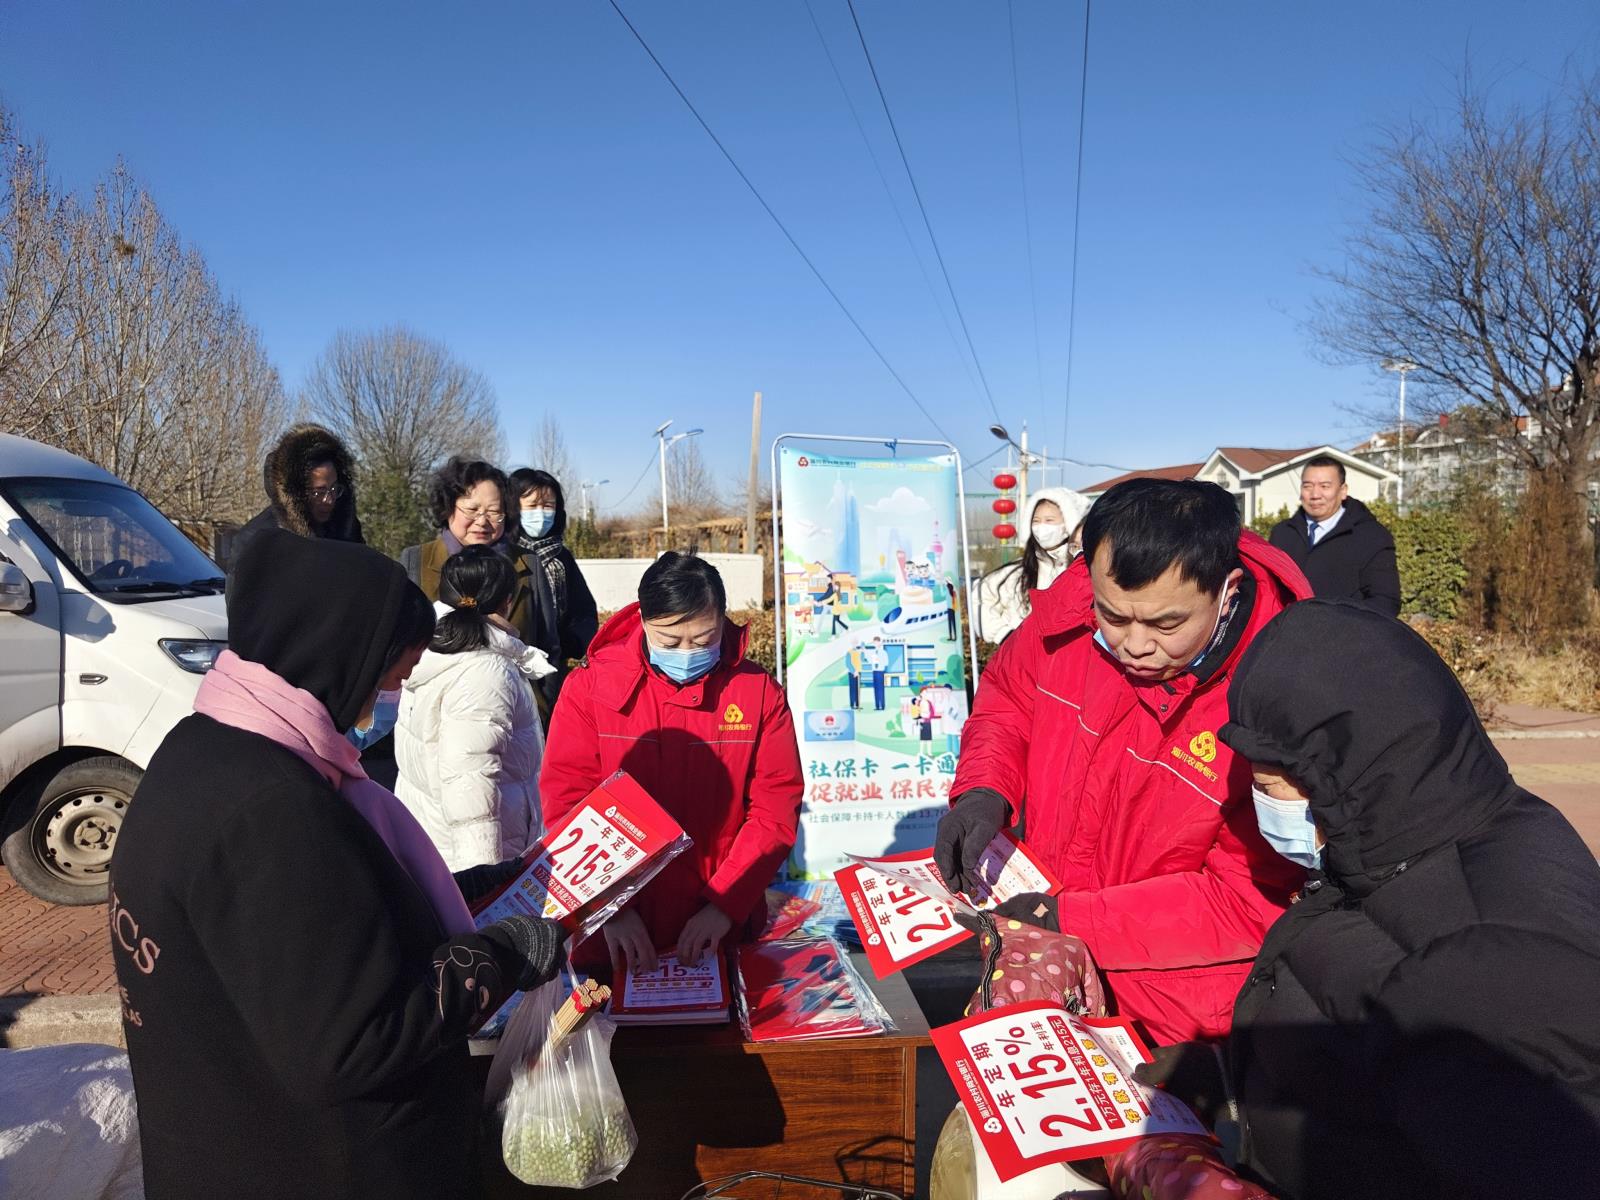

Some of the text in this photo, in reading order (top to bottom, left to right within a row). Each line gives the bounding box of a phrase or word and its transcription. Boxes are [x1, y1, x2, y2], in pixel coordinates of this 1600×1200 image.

[809, 753, 957, 779] 社保卡 一卡通
[810, 782, 883, 803] 促就业
[545, 827, 622, 886] 2.15%
[590, 818, 639, 861] 一年定期
[863, 877, 897, 944] 一年定期
[1030, 1020, 1055, 1051] 年利率
[971, 1041, 1026, 1135] 一年定期
[995, 1025, 1103, 1138] 2.15%
[1051, 1018, 1117, 1124] 1万元存1年利息215元
